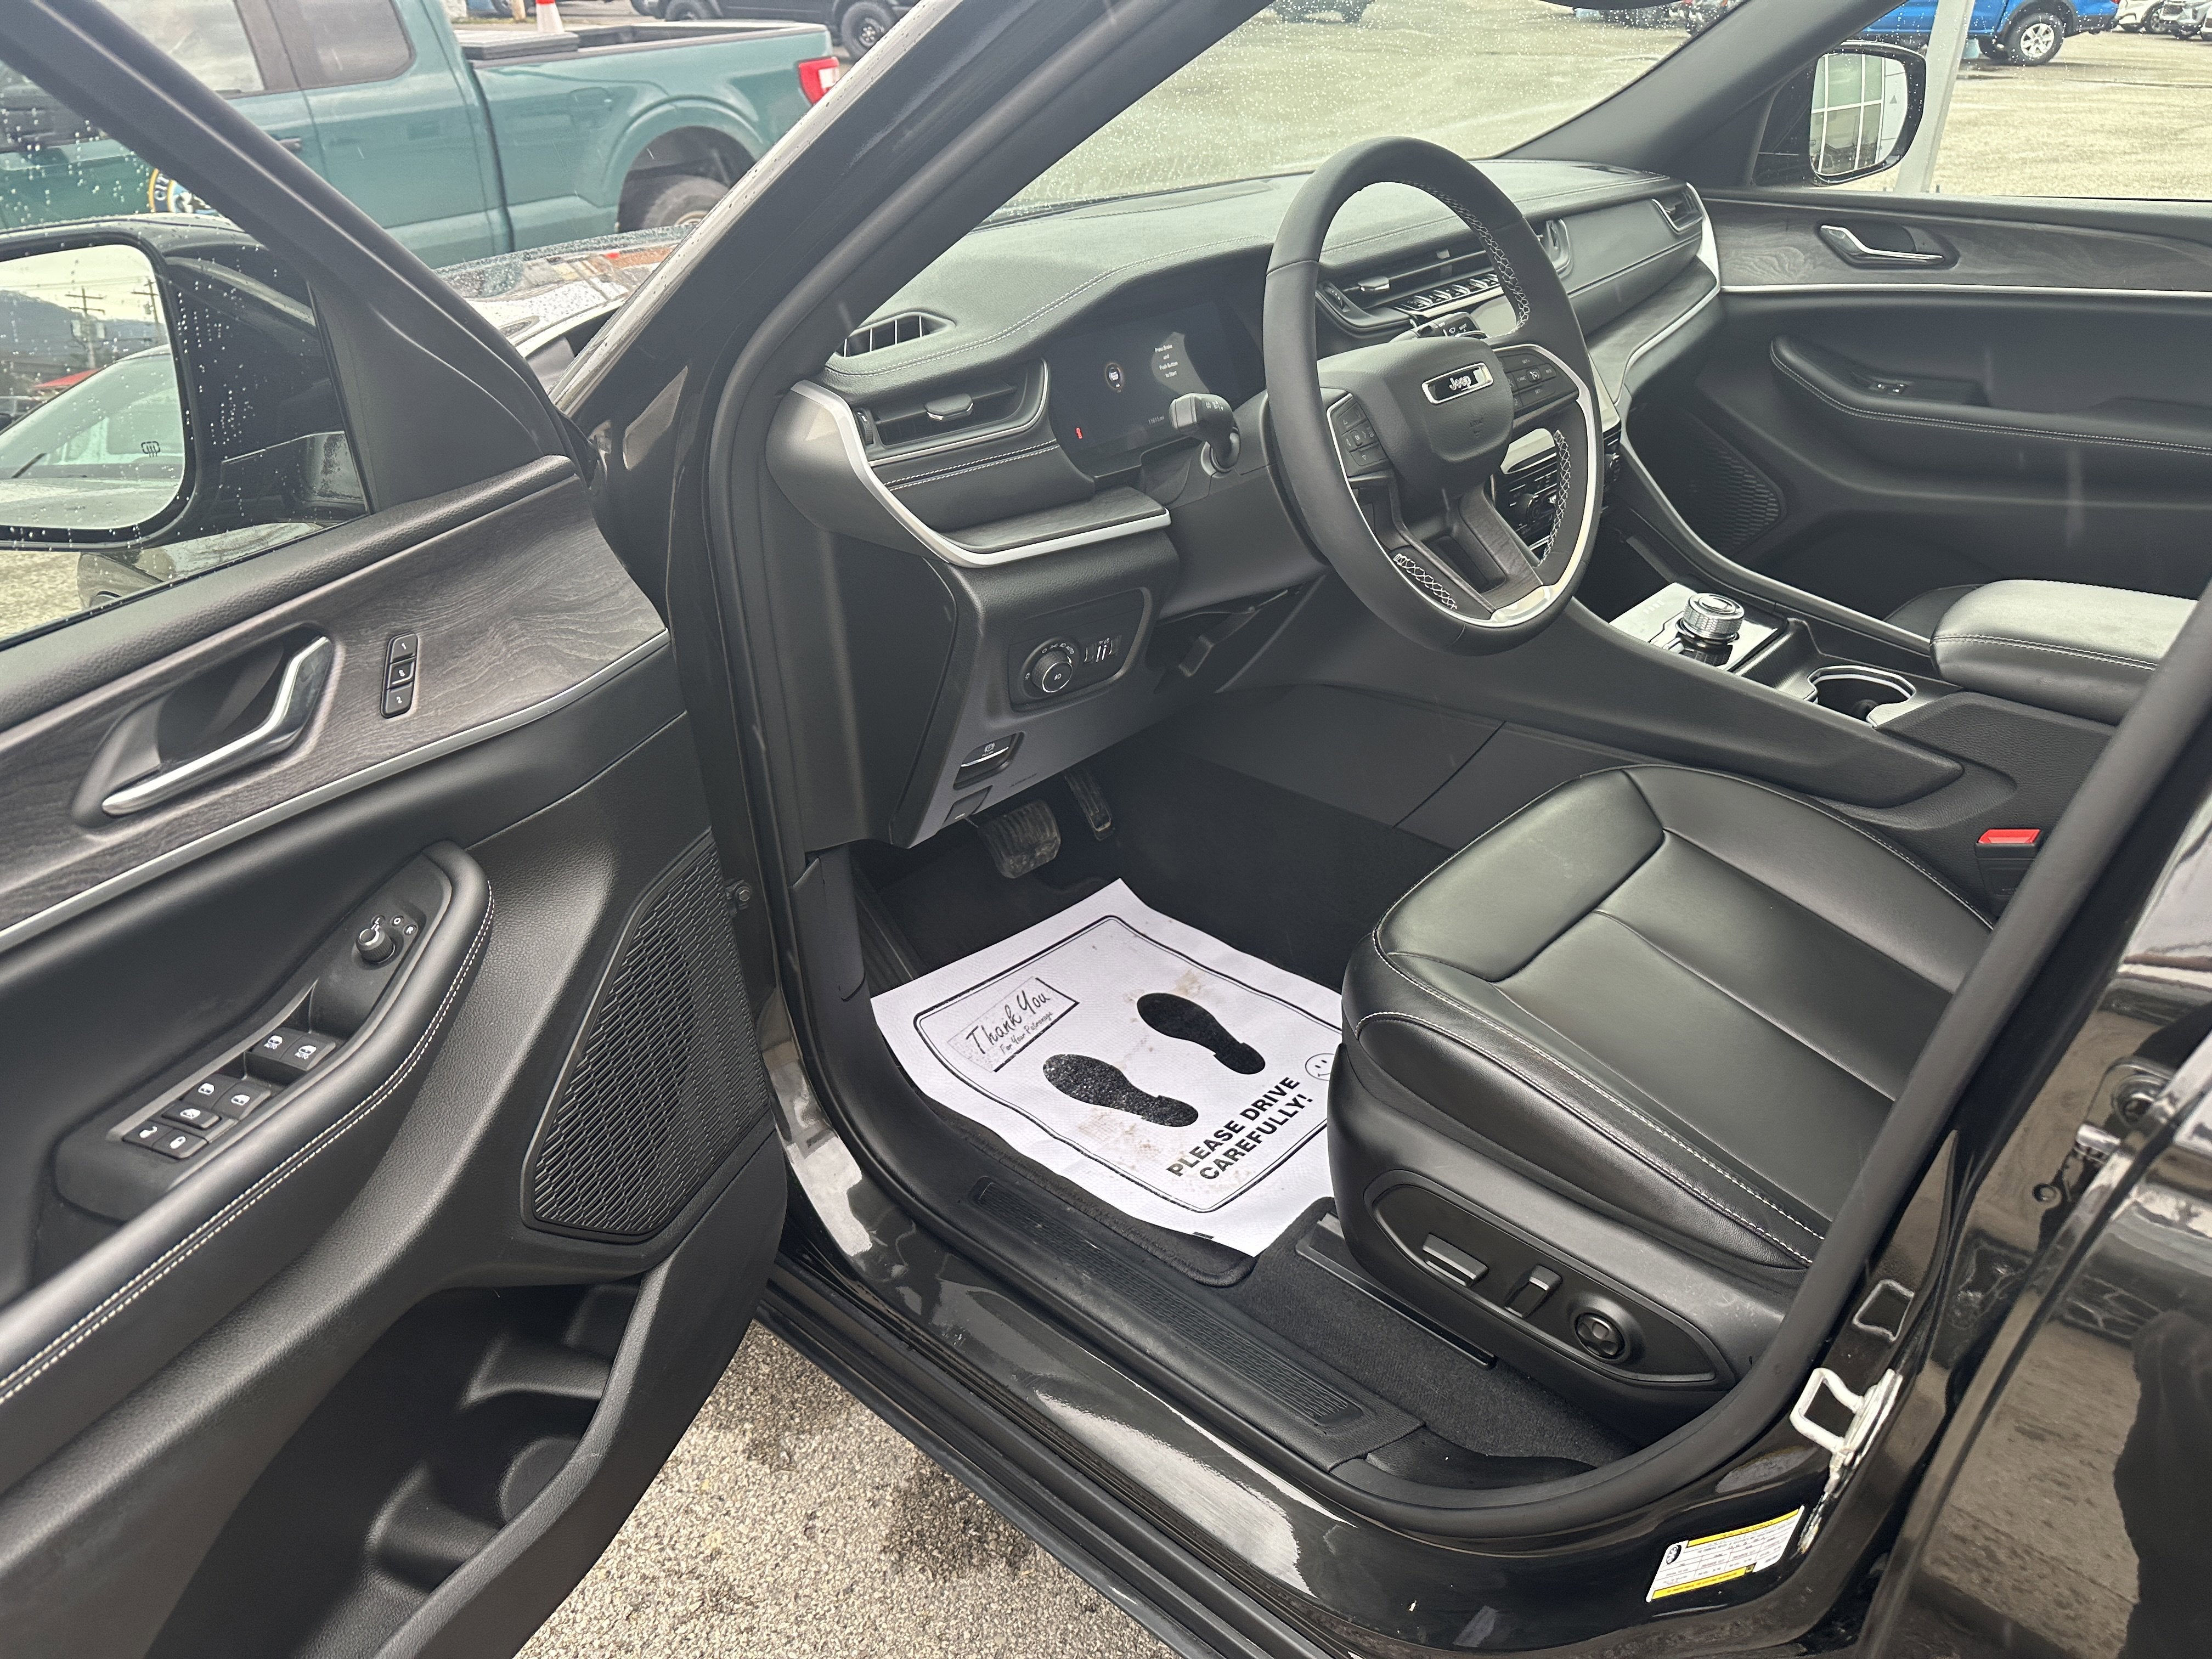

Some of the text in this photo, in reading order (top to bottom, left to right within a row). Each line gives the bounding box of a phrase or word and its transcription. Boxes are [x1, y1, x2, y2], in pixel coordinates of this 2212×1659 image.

[1449, 375, 1472, 391] Jeep
[406, 926, 414, 934] R
[966, 990, 1051, 1054] Thank You
[1000, 1011, 1053, 1054] For Your Patronage
[1165, 1076, 1301, 1177] PLEASE DRIVE
[1199, 1093, 1313, 1180] CAREFULLY!
